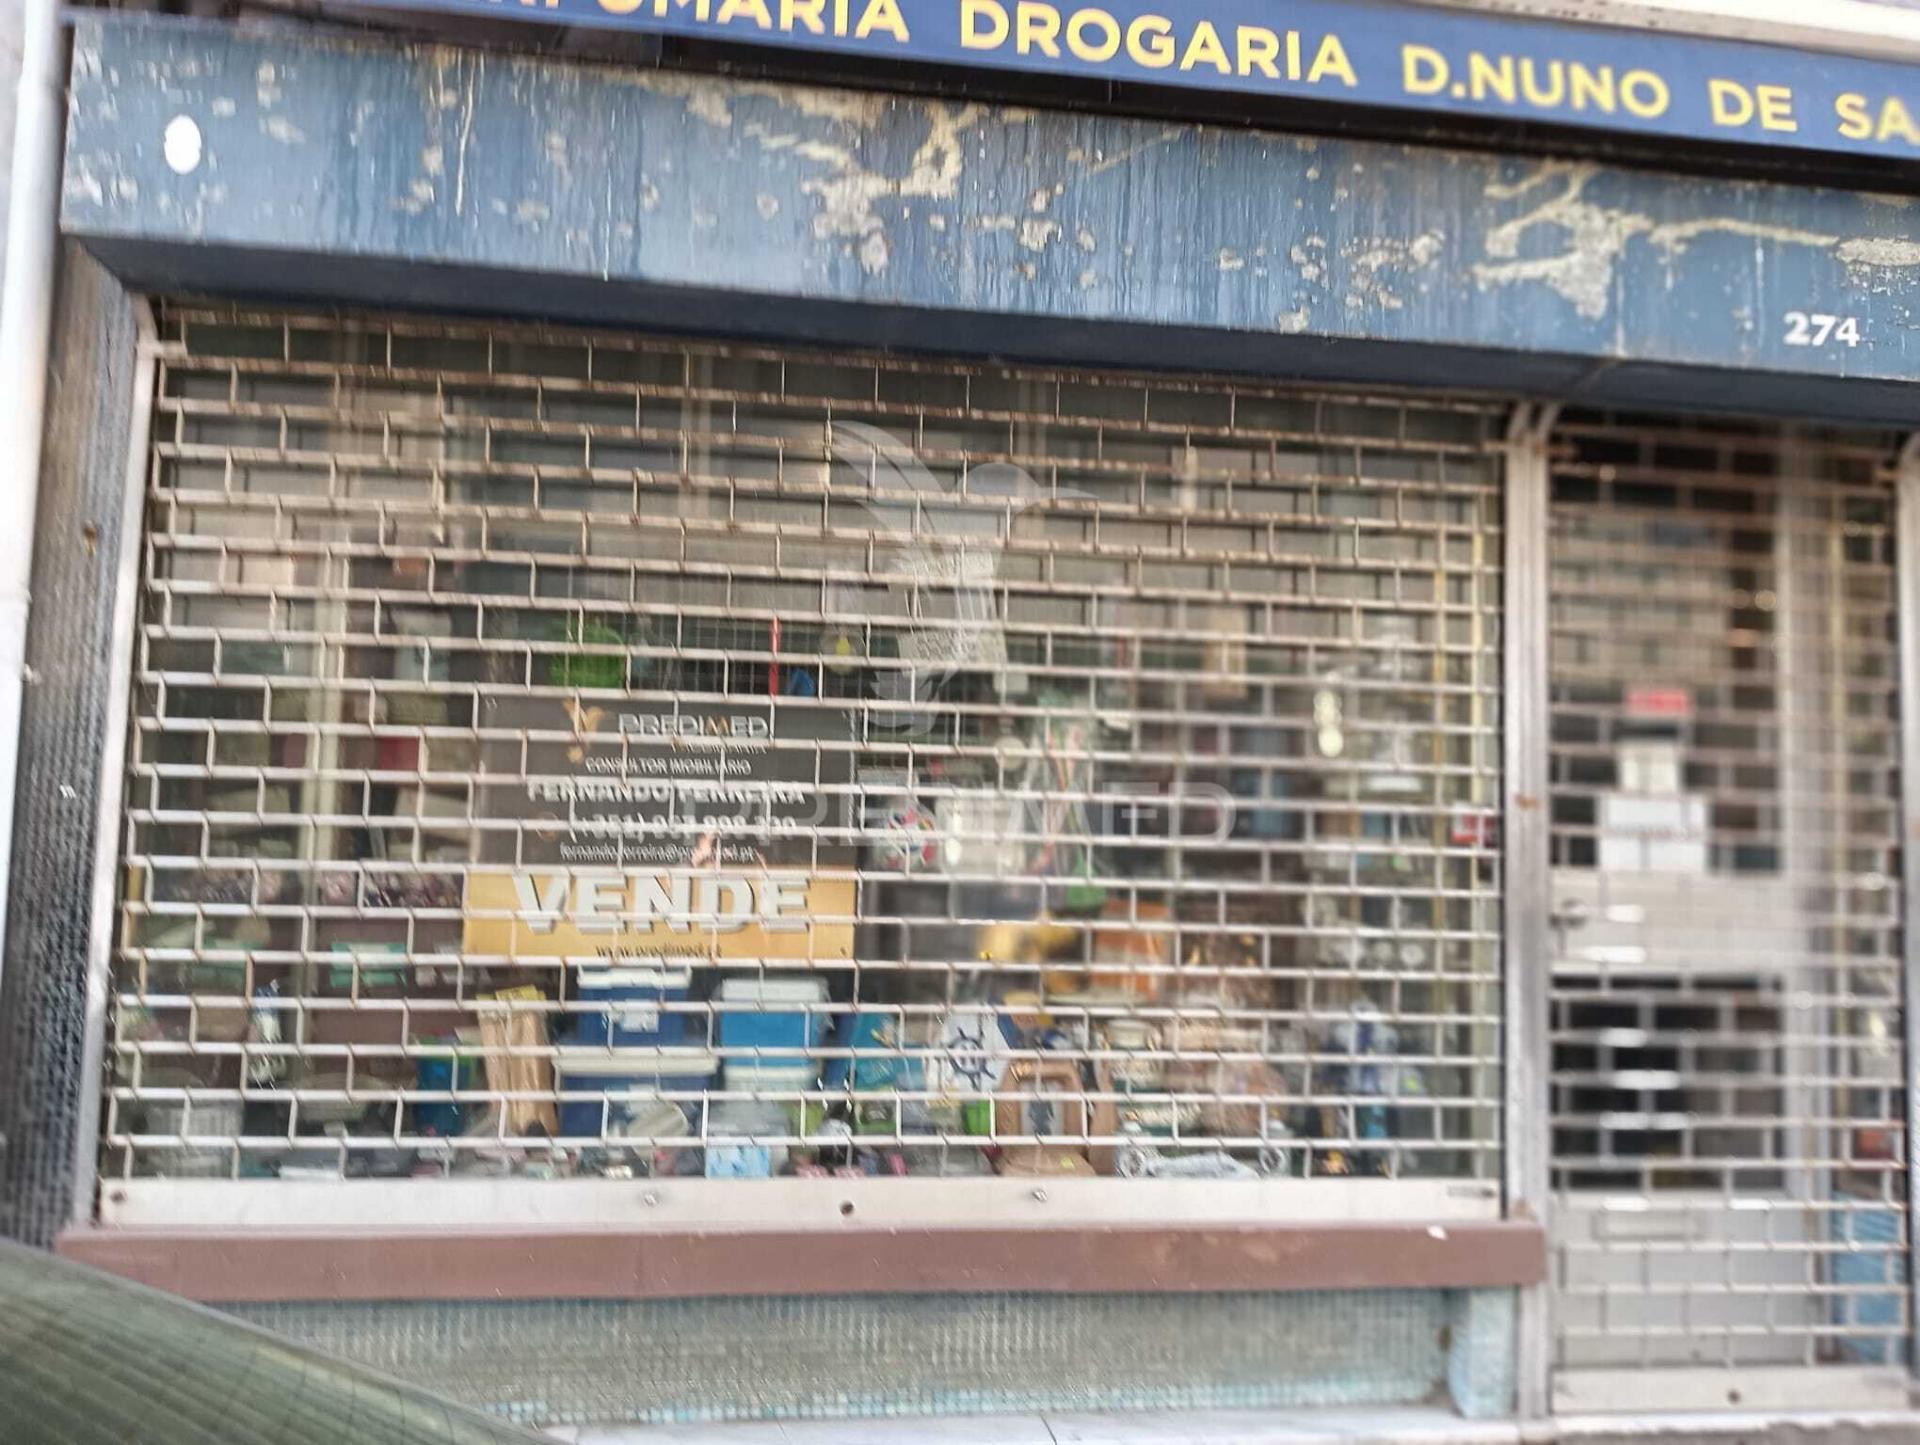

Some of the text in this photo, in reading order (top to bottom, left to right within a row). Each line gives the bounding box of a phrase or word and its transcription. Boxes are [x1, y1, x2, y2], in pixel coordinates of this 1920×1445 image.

[960, 0, 1358, 87] DROGARIA
[1401, 43, 1670, 118] D.NUNO
[1709, 79, 1798, 132] DE
[1783, 310, 1860, 348] 274
[619, 713, 769, 739] PREDIMED
[512, 870, 810, 935] VENDE
